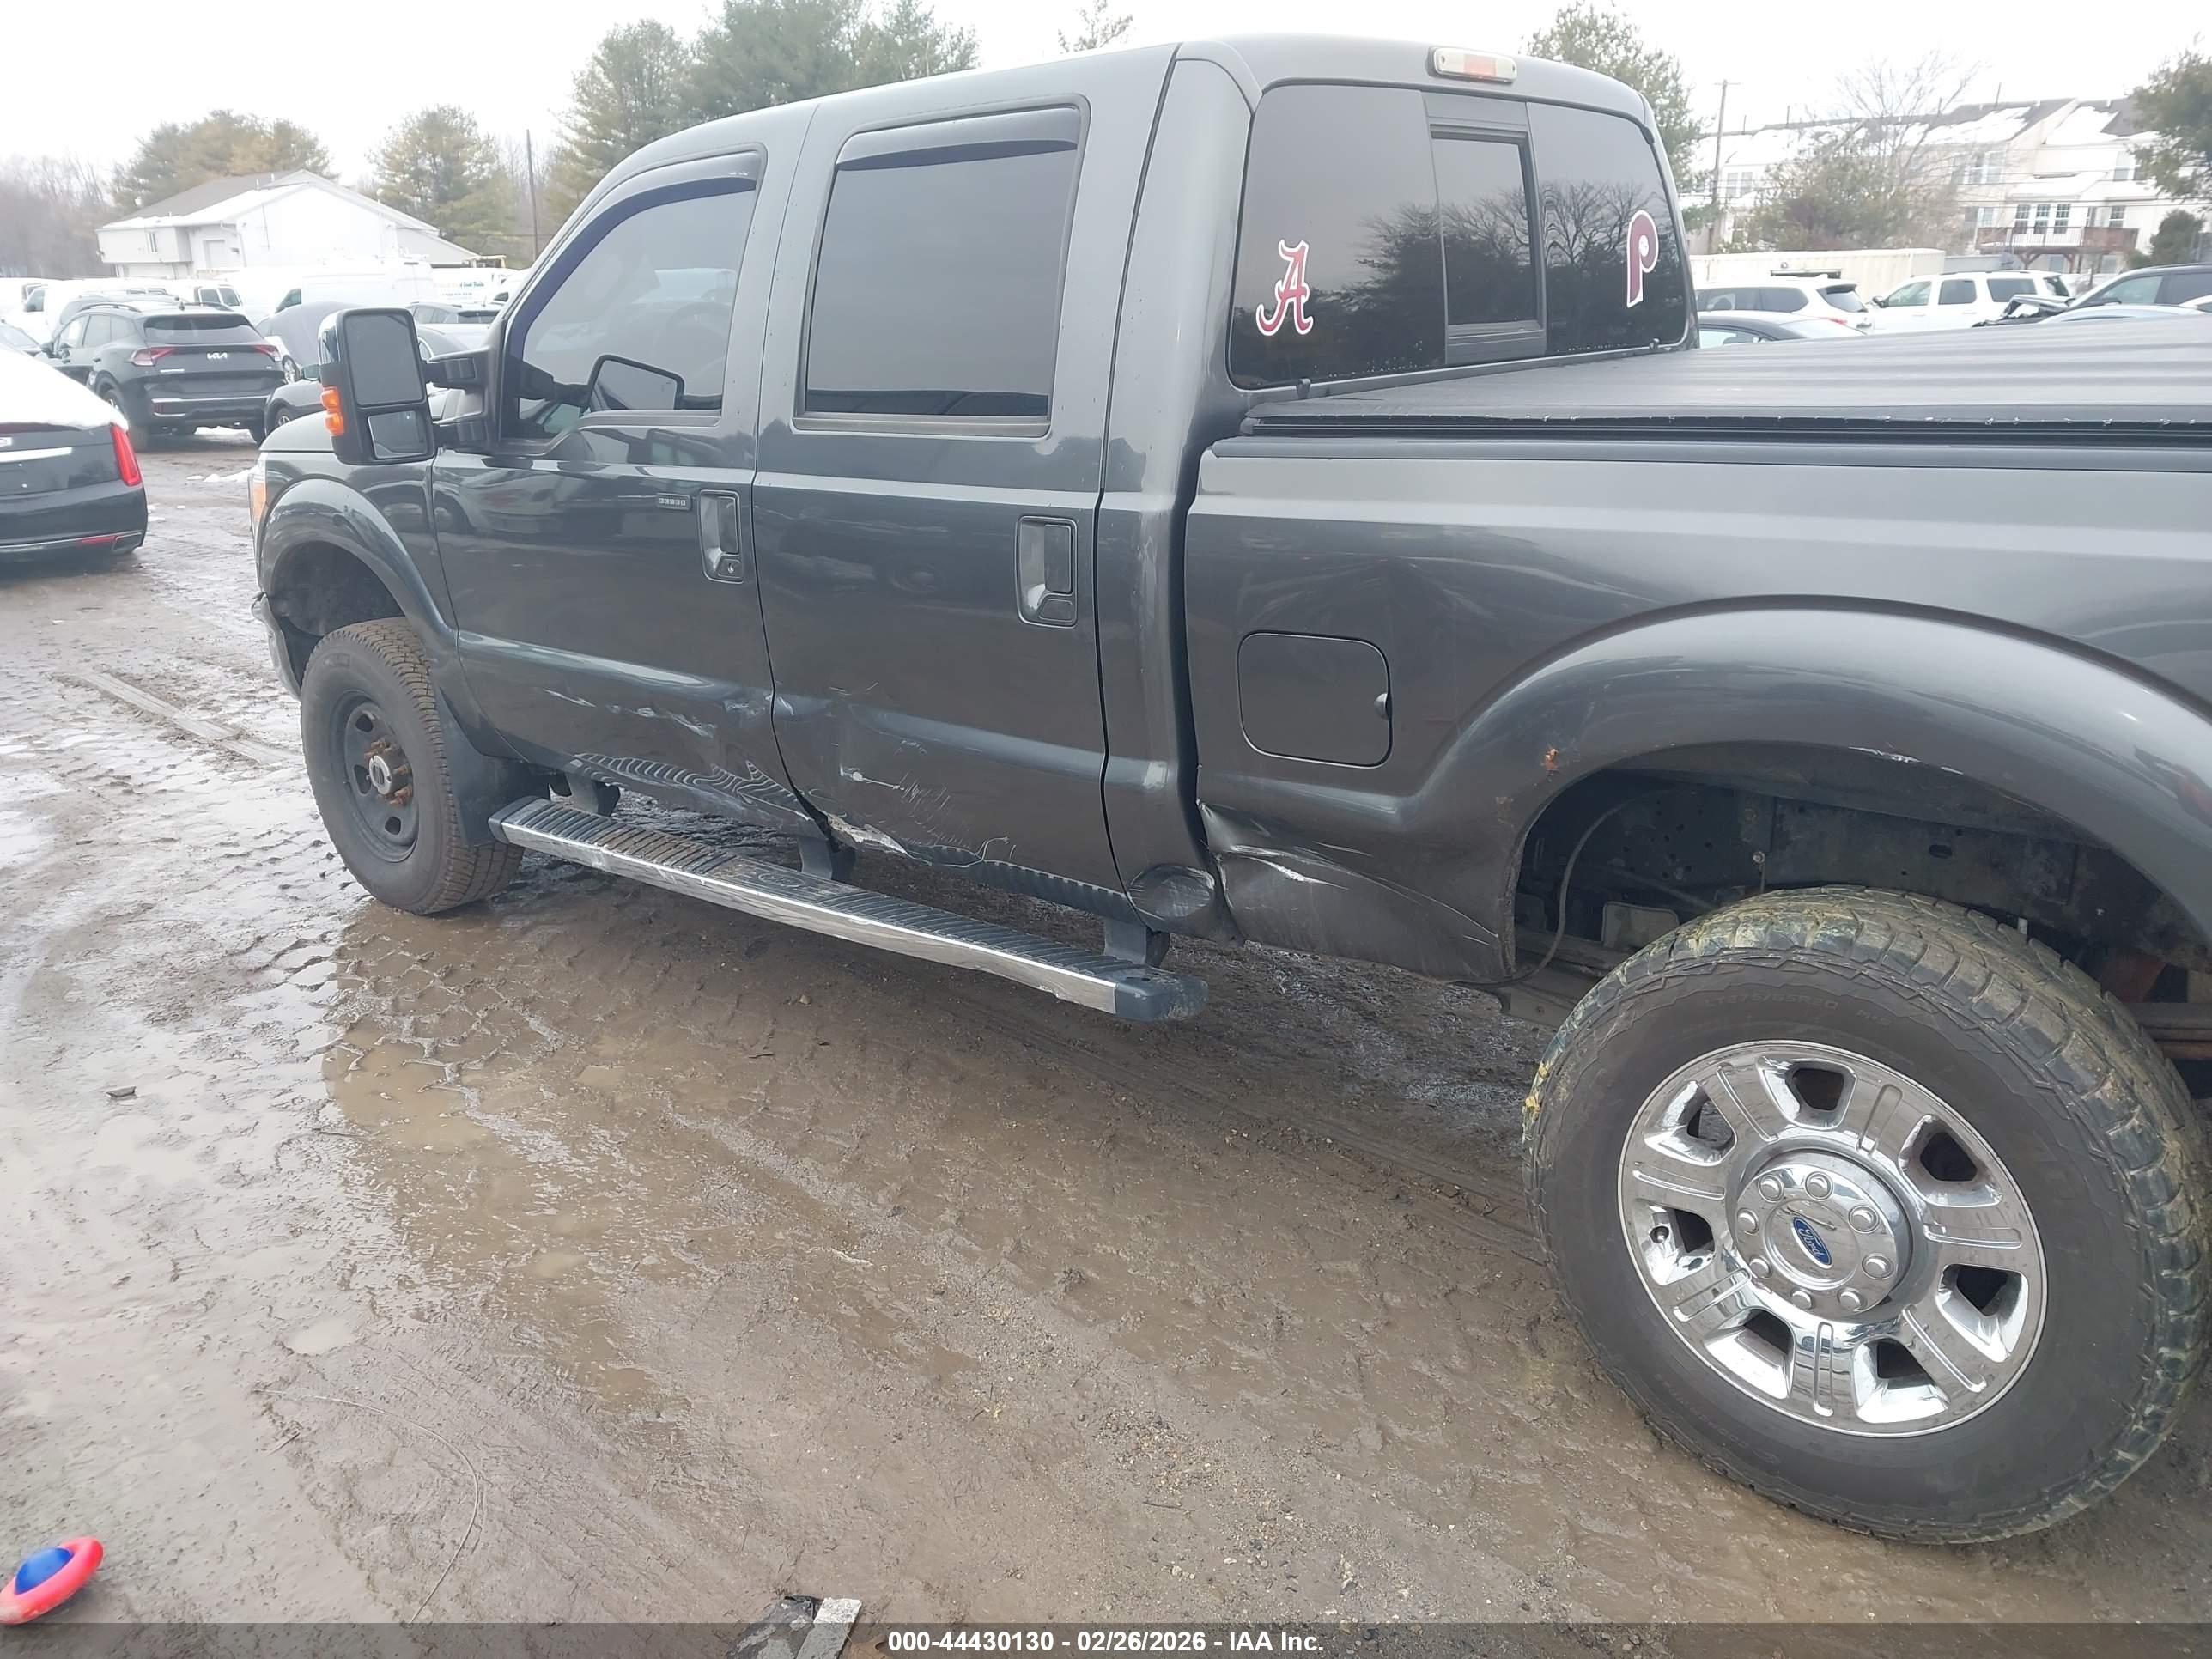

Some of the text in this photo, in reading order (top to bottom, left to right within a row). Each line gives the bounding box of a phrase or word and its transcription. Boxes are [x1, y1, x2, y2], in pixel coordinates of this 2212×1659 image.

[1255, 239, 1314, 337] A
[1626, 210, 1659, 308] P
[1797, 1228, 1826, 1257] Ford
